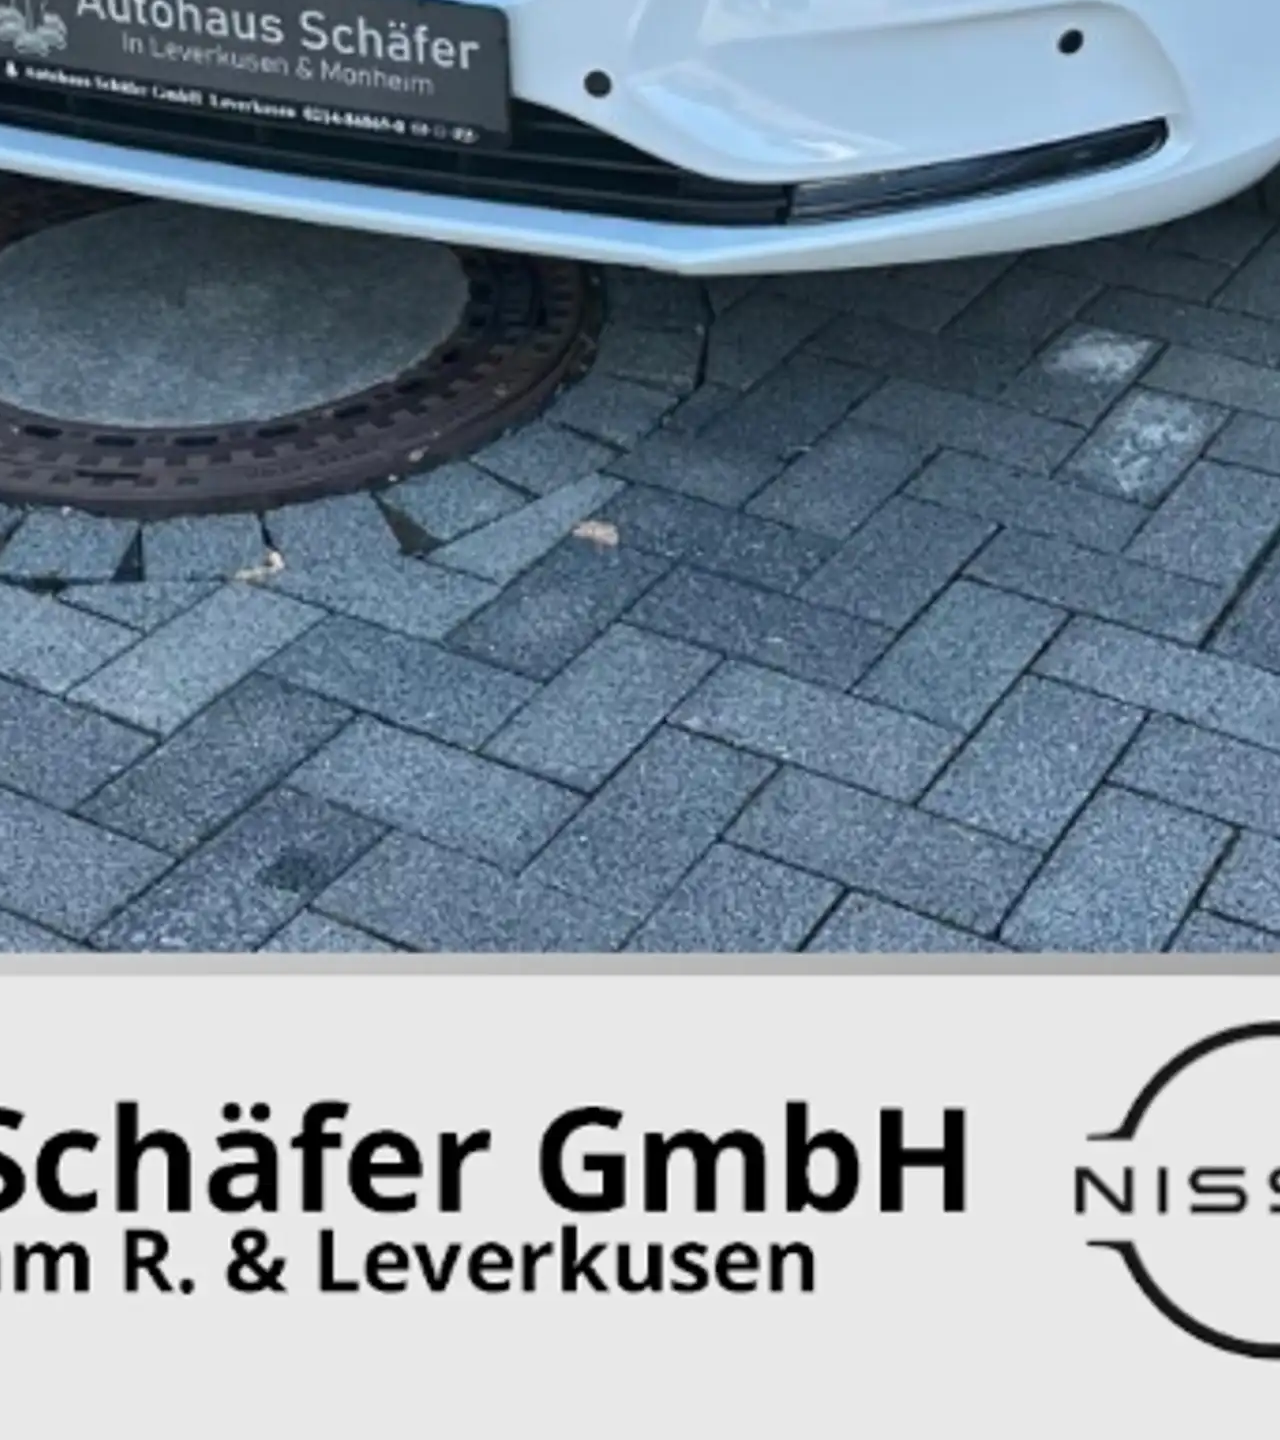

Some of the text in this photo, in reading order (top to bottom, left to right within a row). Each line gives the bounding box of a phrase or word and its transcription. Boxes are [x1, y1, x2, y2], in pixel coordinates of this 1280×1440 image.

[150, 36, 290, 77] Leverkusen
[295, 59, 314, 80] &
[321, 61, 436, 96] Monheim
[298, 9, 481, 71] Schäfer
